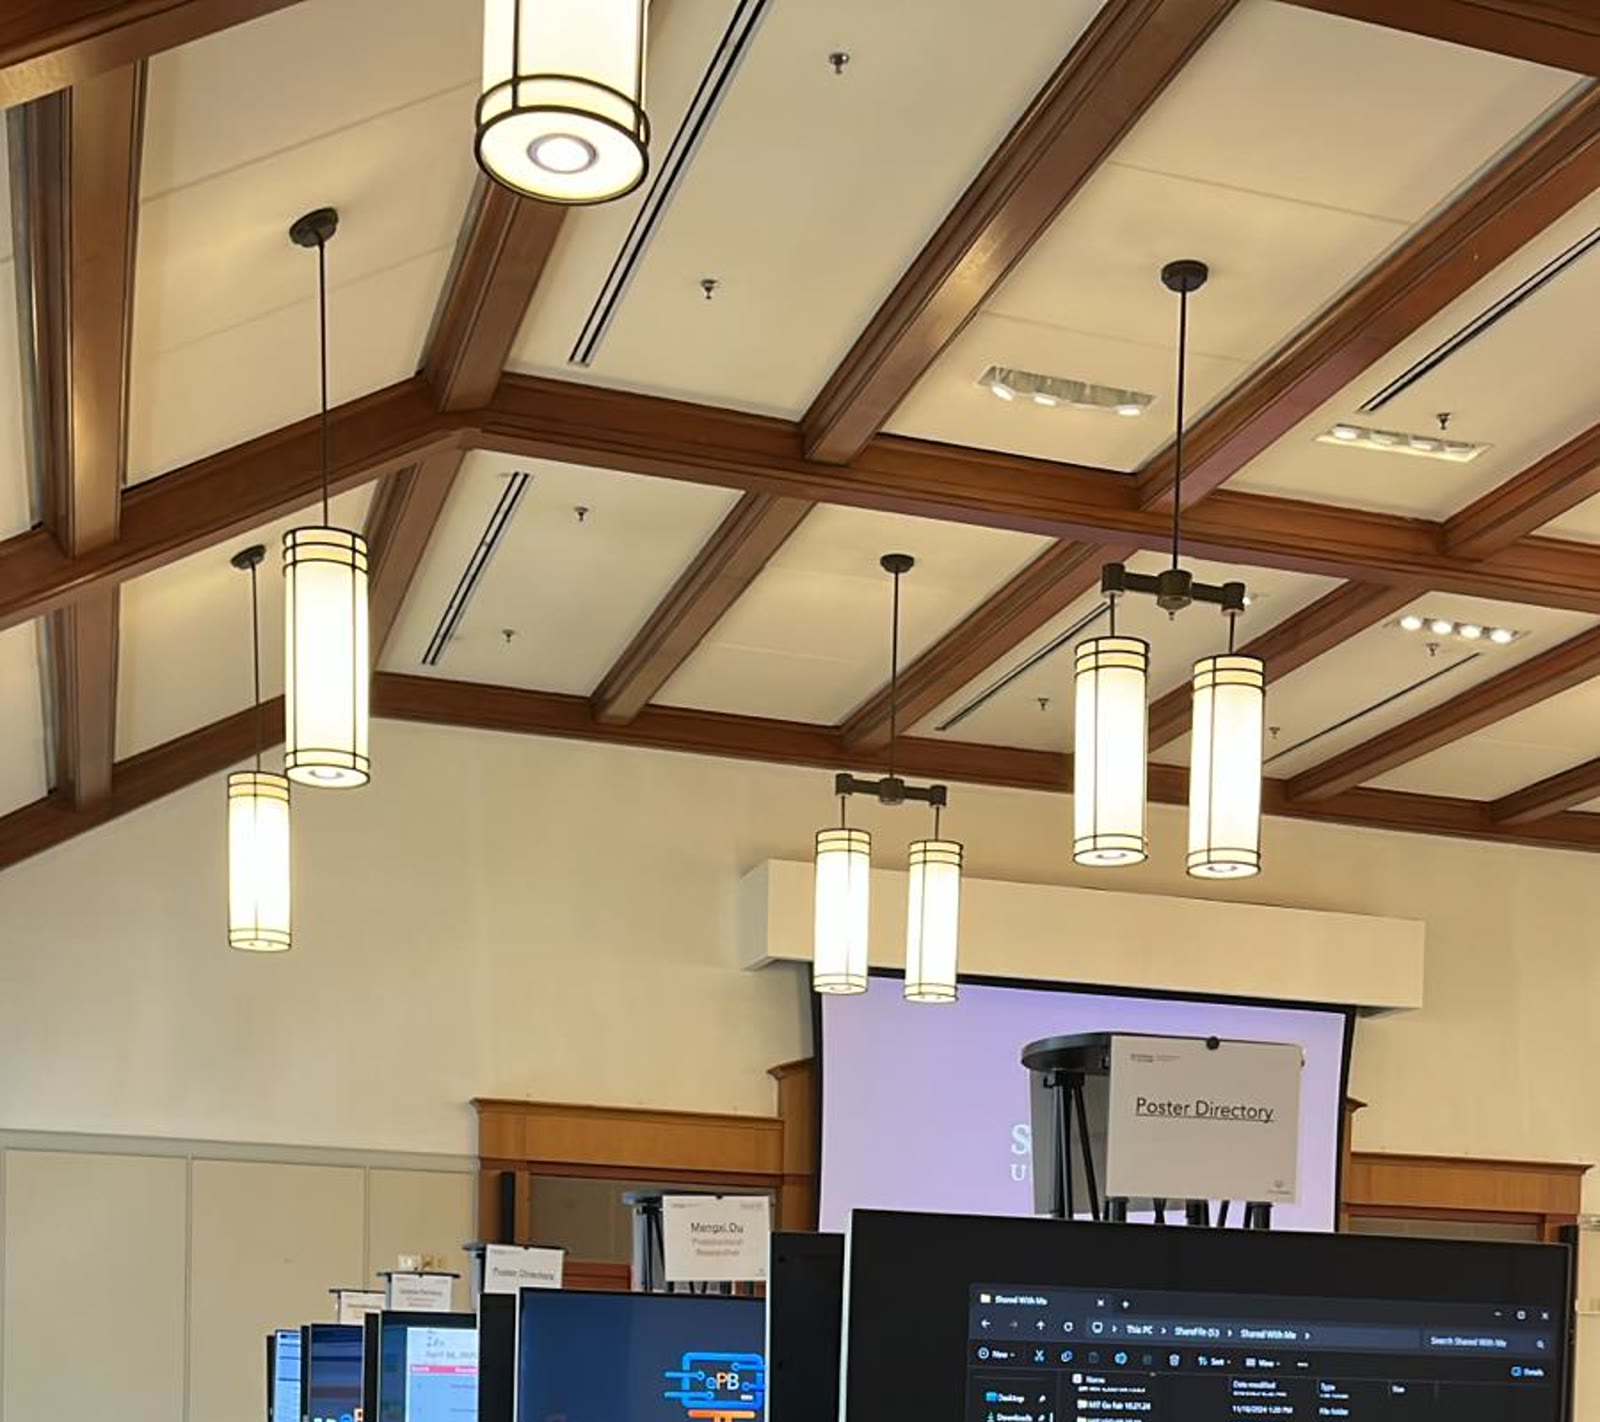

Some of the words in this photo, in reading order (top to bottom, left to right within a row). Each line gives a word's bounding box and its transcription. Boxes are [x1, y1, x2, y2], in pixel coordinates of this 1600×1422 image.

[1136, 1097, 1190, 1117] Poster
[1195, 1099, 1274, 1123] Directory
[994, 1294, 1018, 1304] Shared
[1018, 1295, 1034, 1305] With
[1034, 1297, 1048, 1306] Me
[1125, 1324, 1142, 1335] This
[1142, 1326, 1154, 1336] PC
[1240, 1328, 1265, 1340] Shared
[1266, 1330, 1284, 1341] With
[1284, 1331, 1297, 1341] Me
[1430, 1336, 1453, 1346] Search
[1454, 1337, 1478, 1347] Shared
[1478, 1338, 1494, 1348] With
[1494, 1339, 1508, 1349] Me
[991, 1349, 1009, 1360] New
[1210, 1357, 1225, 1367] Sort
[1258, 1358, 1275, 1369] View
[706, 1372, 740, 1391] ePB
[1085, 1375, 1106, 1385] Name
[1320, 1382, 1336, 1393] Type
[997, 1392, 1026, 1404] Desktop
[995, 1411, 1034, 1422] Downloads
